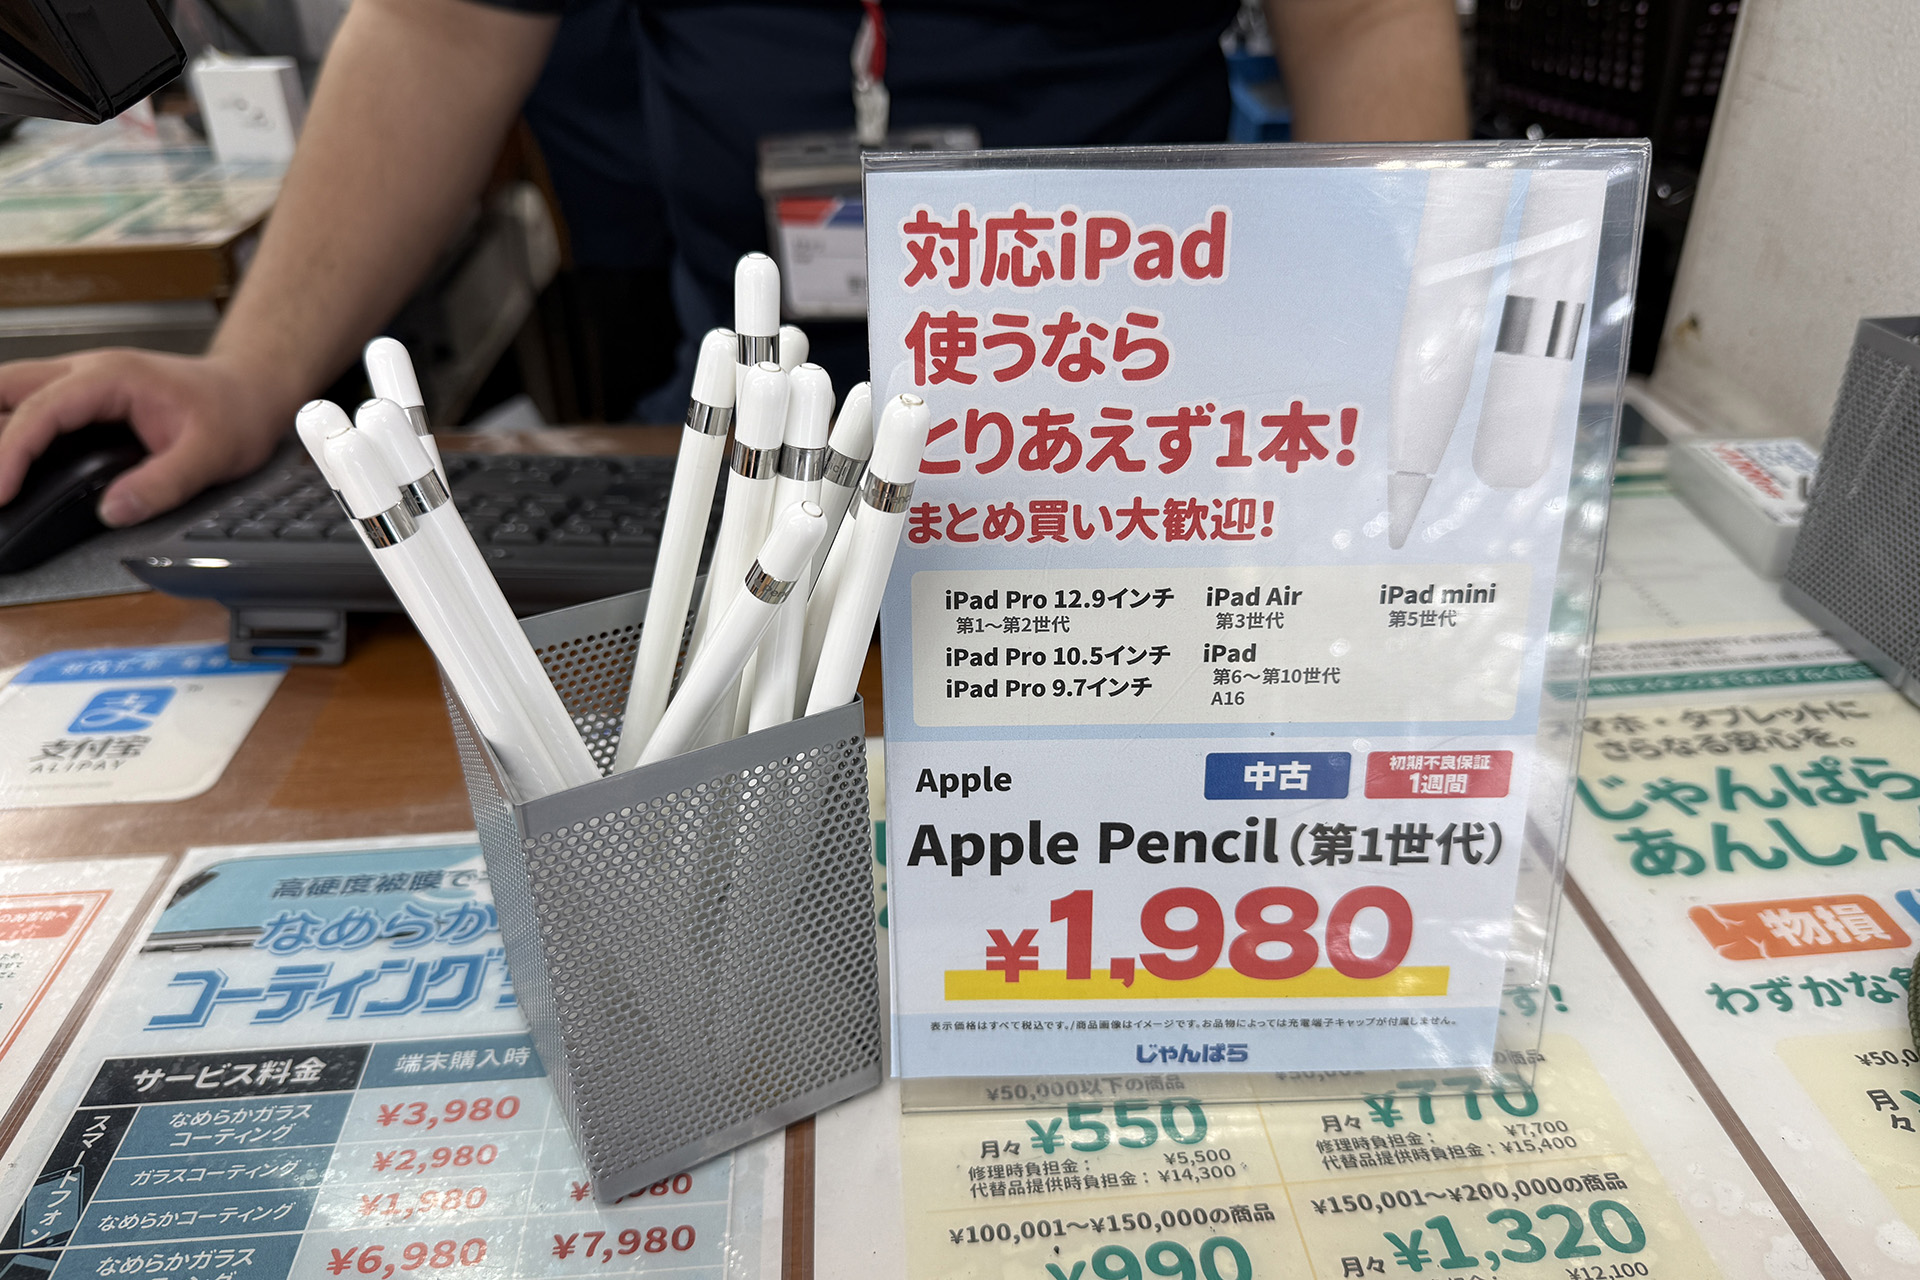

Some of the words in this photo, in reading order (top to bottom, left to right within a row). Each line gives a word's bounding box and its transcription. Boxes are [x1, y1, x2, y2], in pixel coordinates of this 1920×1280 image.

[902, 208, 1228, 289] 対応iPad
[903, 309, 1170, 386] 使うなら
[907, 495, 1275, 544] まとめ買い大歓迎!
[945, 589, 999, 610] iPad
[1005, 590, 1048, 610] Pro
[1053, 587, 1175, 609] 12.9インチ
[1205, 585, 1261, 607] iPad
[1265, 585, 1303, 606] Air
[1378, 583, 1435, 605] iPad
[1440, 582, 1497, 604] mini
[956, 615, 1071, 634] 第1〜第2世代
[1215, 611, 1285, 630] 第3世代
[1387, 609, 1458, 628] 第5世代
[945, 646, 999, 667] iPad
[1005, 647, 1047, 666] Pro
[1053, 644, 1171, 666] 10.5インチ
[1202, 642, 1258, 663] iPad
[945, 678, 999, 698] iPad
[1005, 679, 1047, 697] Pro
[1052, 676, 1153, 698] 9.7インチ
[1212, 666, 1341, 686] 第6〜第10世代
[1210, 690, 1246, 706] A16
[29, 759, 127, 774] ALIPAY
[1389, 754, 1492, 771] 初期不良保証
[915, 765, 1013, 799] Apple
[1243, 760, 1311, 792] 中古
[1408, 772, 1469, 794] 1週間
[1575, 755, 1920, 821] じゃんぱら
[906, 819, 1080, 877] Apple
[985, 885, 1414, 988] ¥1,980
[1755, 903, 1892, 947] 物損
[394, 1045, 533, 1074] 端末購入時
[1135, 1042, 1249, 1064] じゃんぱら
[133, 1055, 328, 1094] サービス料金
[169, 1103, 314, 1129] なめらかガラス
[375, 1095, 521, 1131] ¥3,980
[1024, 1095, 1208, 1155] ¥550
[1320, 1113, 1362, 1133] 月々
[169, 1122, 297, 1148] コーティング
[1503, 1119, 1569, 1138] ¥7,700
[980, 1138, 1021, 1159] 月々
[1162, 1147, 1232, 1167] ¥5,500
[1500, 1134, 1578, 1155] ¥15,400
[371, 1143, 499, 1175] ¥2,980
[22, 1114, 112, 1248] スマートフォン
[130, 1158, 303, 1187] ガラスコーティング
[1157, 1163, 1237, 1183] ¥14,300
[360, 1185, 488, 1220] ¥1,980
[97, 1201, 297, 1232] なめらかコーティング
[551, 1224, 697, 1264] ¥7,980
[1340, 1253, 1387, 1279] 月々
[1382, 1198, 1647, 1273] ¥1,320
[95, 1247, 257, 1277] なめらかガラス
[326, 1236, 488, 1280] ¥6,980
